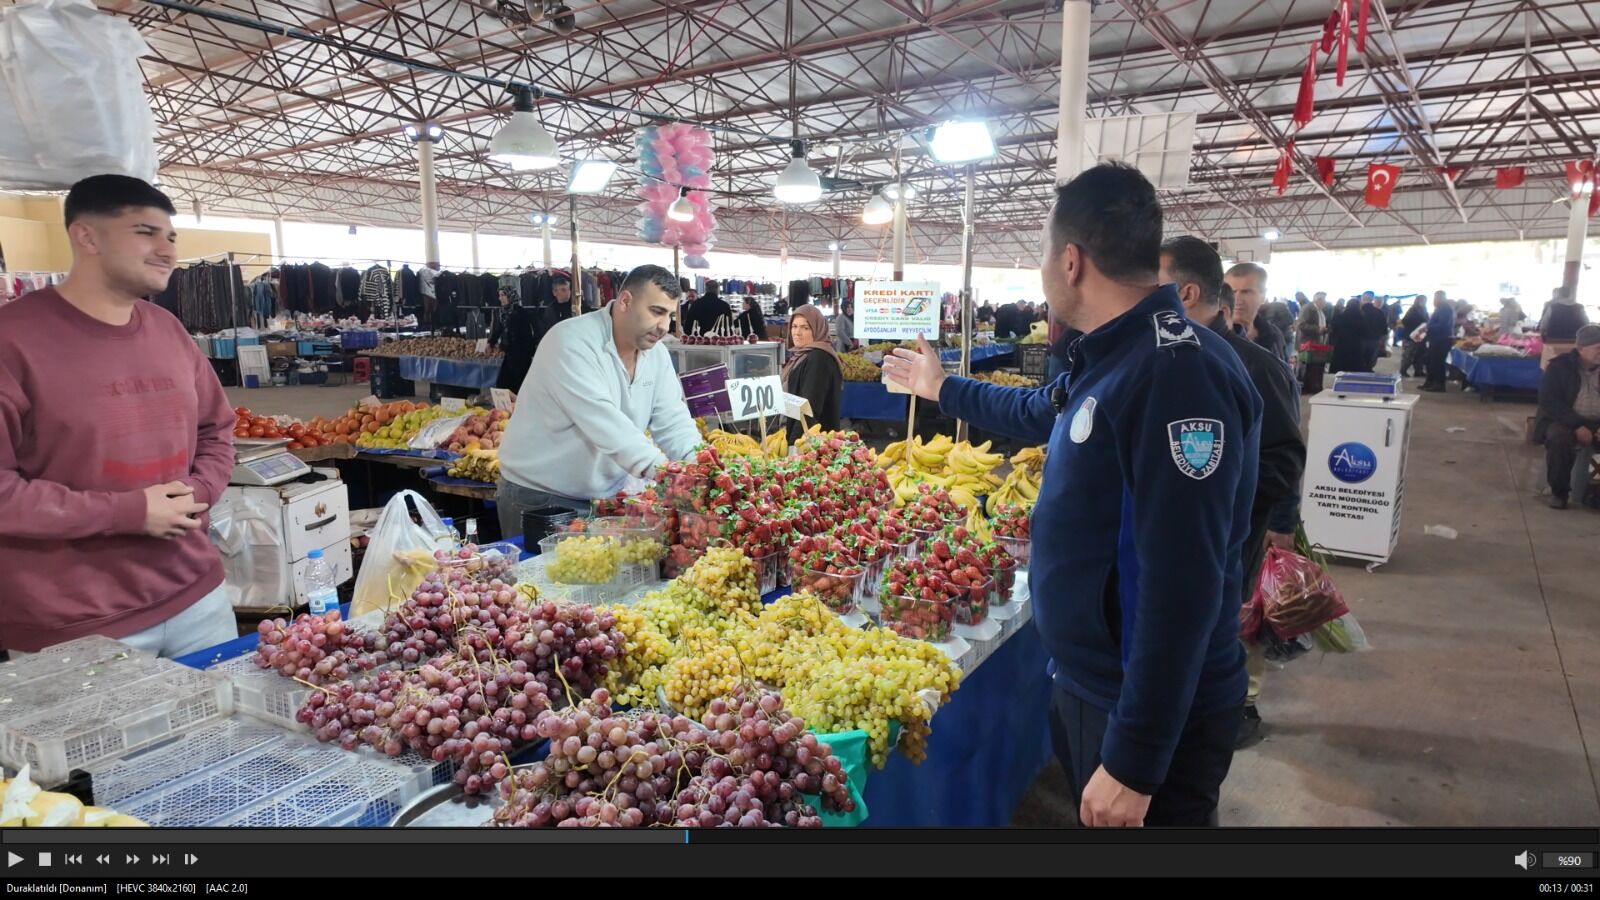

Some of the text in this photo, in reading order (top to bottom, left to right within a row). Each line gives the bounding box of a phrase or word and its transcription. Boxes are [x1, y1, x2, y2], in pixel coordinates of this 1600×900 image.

[863, 296, 905, 304] GEÇERLİDİR
[863, 325, 897, 333] AYDOĞANLAR
[1181, 422, 1212, 432] AKSU
[1333, 448, 1371, 467] Aksu
[1338, 488, 1385, 497] BELEDİYESİ
[1308, 492, 1390, 507] ZABITA MÜDÜRLÜĞÜ
[1317, 501, 1379, 514] TARTI KONTROL
[1329, 512, 1364, 520] NOKTASI
